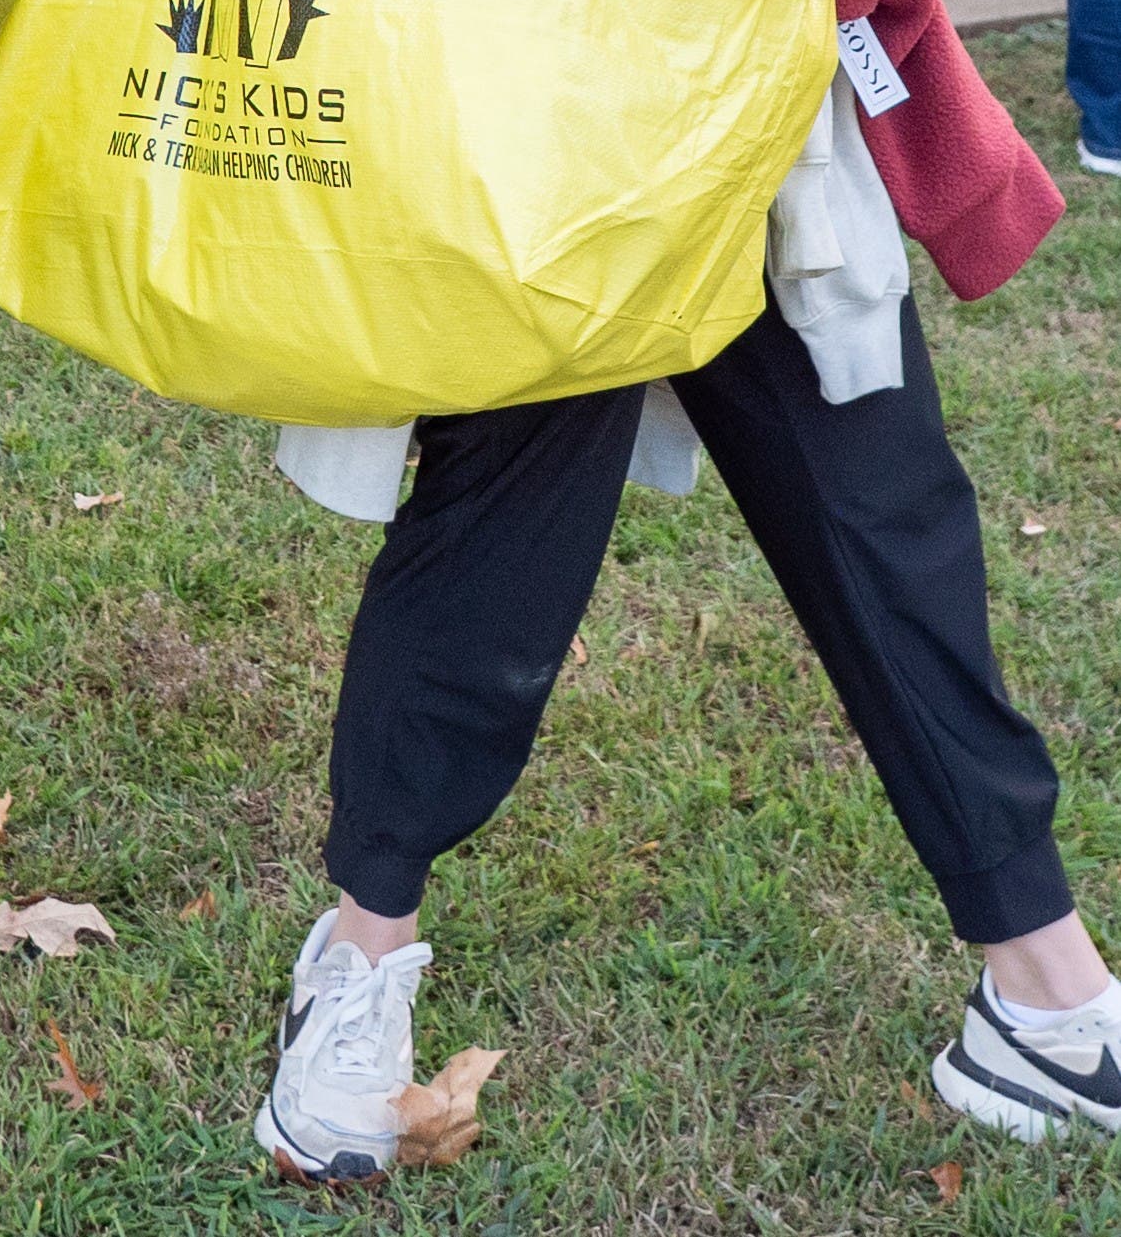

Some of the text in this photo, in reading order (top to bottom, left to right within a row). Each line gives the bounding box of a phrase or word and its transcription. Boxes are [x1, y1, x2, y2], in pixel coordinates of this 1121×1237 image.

[241, 83, 345, 122] KIDS
[160, 113, 306, 148] FONDATION
[107, 131, 142, 159] NICK
[143, 138, 157, 162] &
[222, 151, 280, 182] HELPING
[286, 153, 352, 189] CHILDREN
